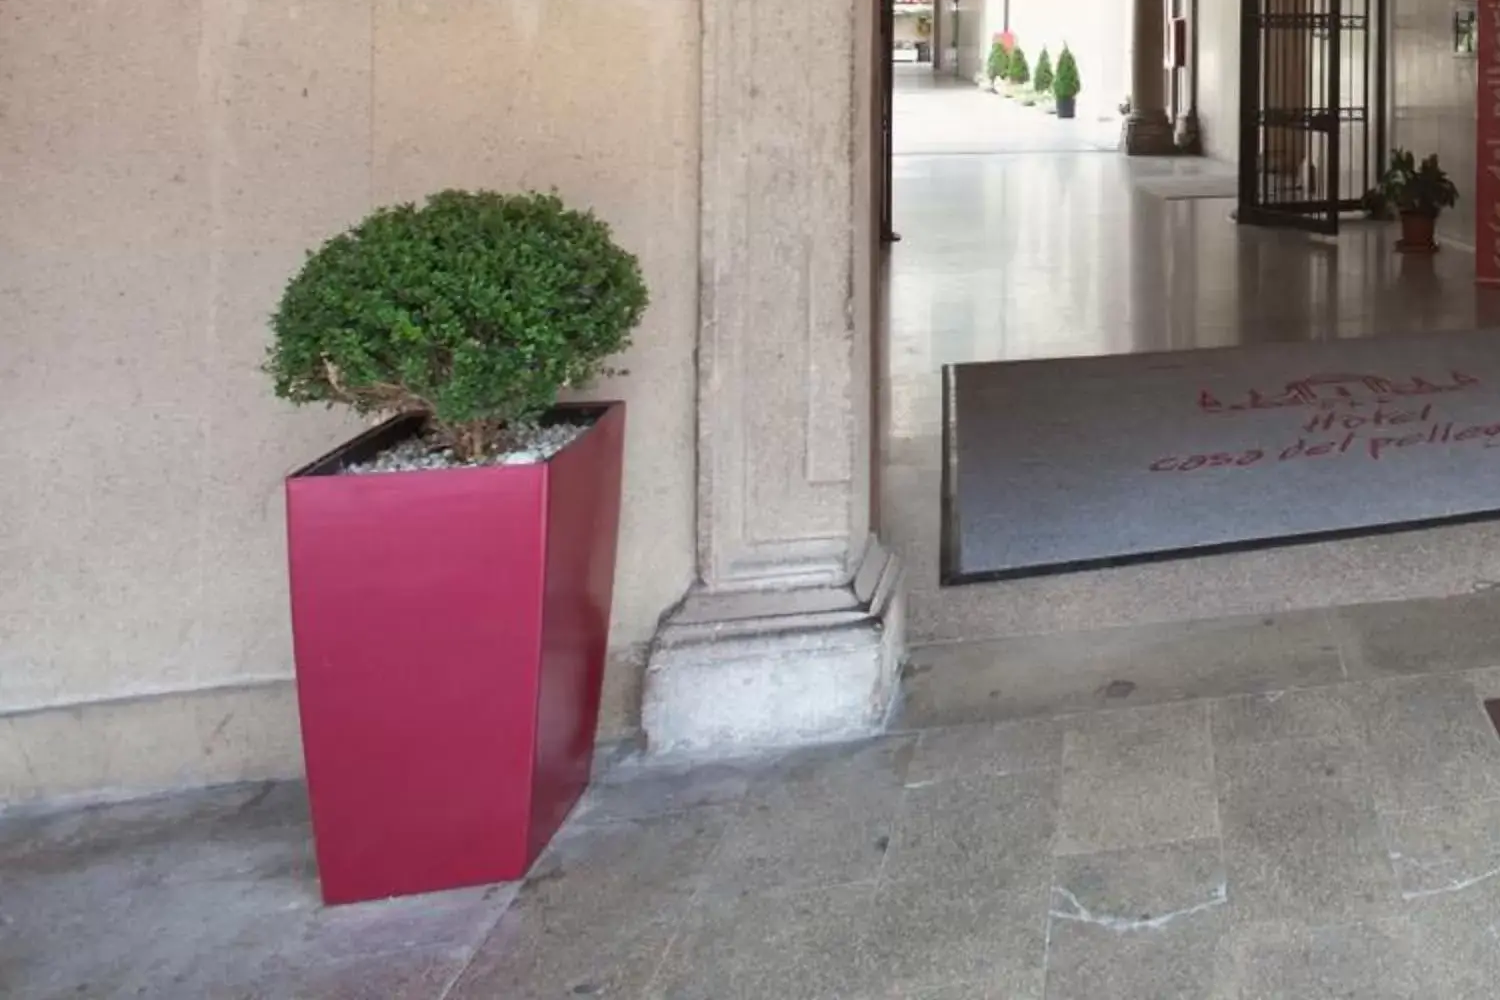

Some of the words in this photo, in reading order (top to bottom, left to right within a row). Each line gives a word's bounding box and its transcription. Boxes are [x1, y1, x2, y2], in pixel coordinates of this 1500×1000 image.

[1303, 403, 1432, 433] Hotel
[1149, 450, 1265, 472] casa
[1277, 432, 1355, 461] del
